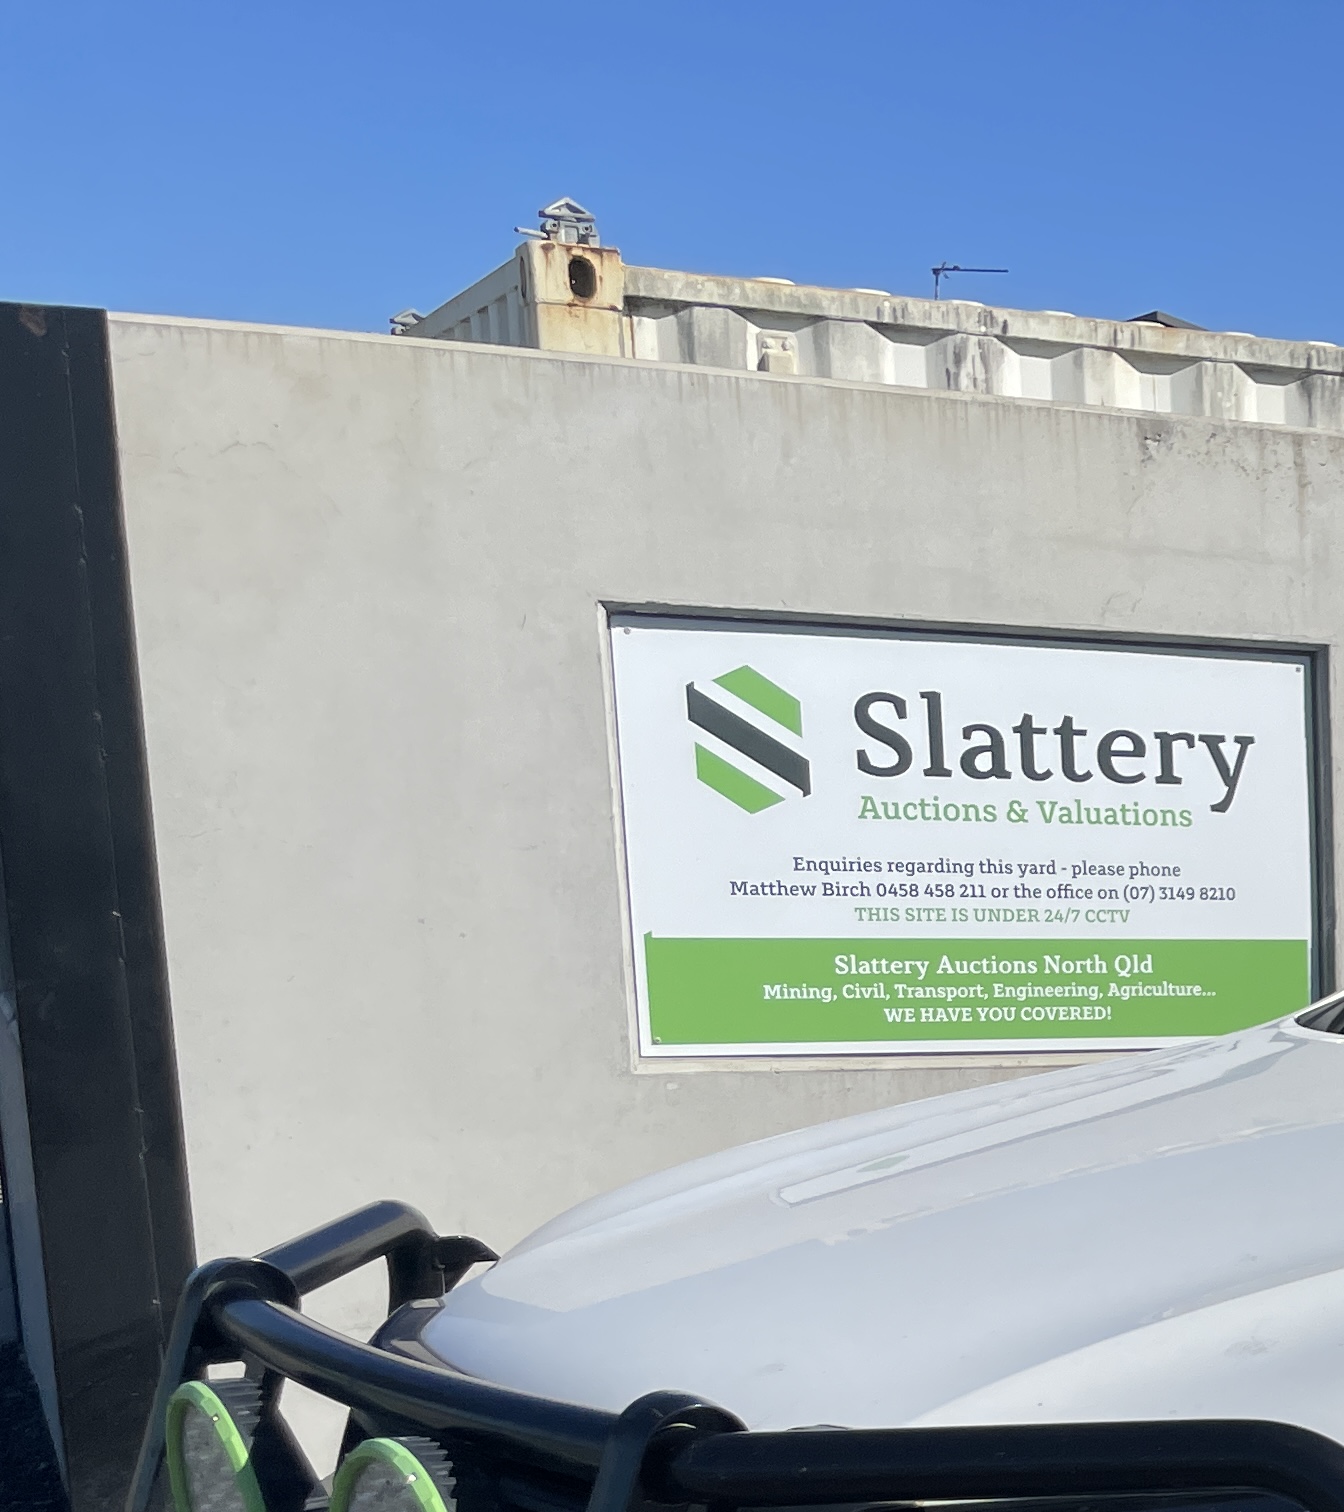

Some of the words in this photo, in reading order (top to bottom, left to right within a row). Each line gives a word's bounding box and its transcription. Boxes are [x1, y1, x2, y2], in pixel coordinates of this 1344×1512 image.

[853, 690, 1255, 814] Slattery
[857, 796, 998, 824] Auctions
[1006, 799, 1029, 824] &
[1037, 800, 1193, 828] Valuations
[792, 856, 883, 876] Enquiries
[886, 858, 975, 878] regarding
[978, 858, 1013, 875] this
[1018, 860, 1057, 879] yard
[1071, 860, 1125, 879] please
[1128, 861, 1182, 880] phone
[729, 880, 817, 897] Matthew
[821, 881, 872, 898] Birch
[876, 883, 919, 898] 0458
[924, 883, 955, 898] 458
[959, 884, 985, 899] 211
[990, 887, 1010, 899] or
[1013, 884, 1042, 899] the
[1046, 884, 1094, 900] office
[1097, 887, 1120, 901] on
[1123, 884, 1156, 903] (07)
[1159, 886, 1196, 901] 3149
[1199, 887, 1236, 901] 8210
[854, 907, 901, 922] THIS
[904, 907, 947, 922] SITE
[951, 908, 969, 922] IS
[973, 908, 1040, 923] UNDER
[1044, 908, 1081, 924] 24/7
[1084, 909, 1131, 923] CCTV
[834, 954, 930, 980] Slattery
[936, 955, 1038, 974] Auctions
[1043, 954, 1108, 974] North
[1114, 954, 1154, 978] Qld
[763, 983, 838, 1003] Mining,
[842, 983, 891, 1001] Civil,
[894, 983, 989, 1002] Transport,
[992, 982, 1104, 1001] Engineering,
[1107, 981, 1217, 1001] Agriculture...
[883, 1007, 916, 1022] WE
[920, 1007, 973, 1022] HAVE
[976, 1007, 1016, 1021] YOU
[1020, 1006, 1112, 1021] COVERED!
